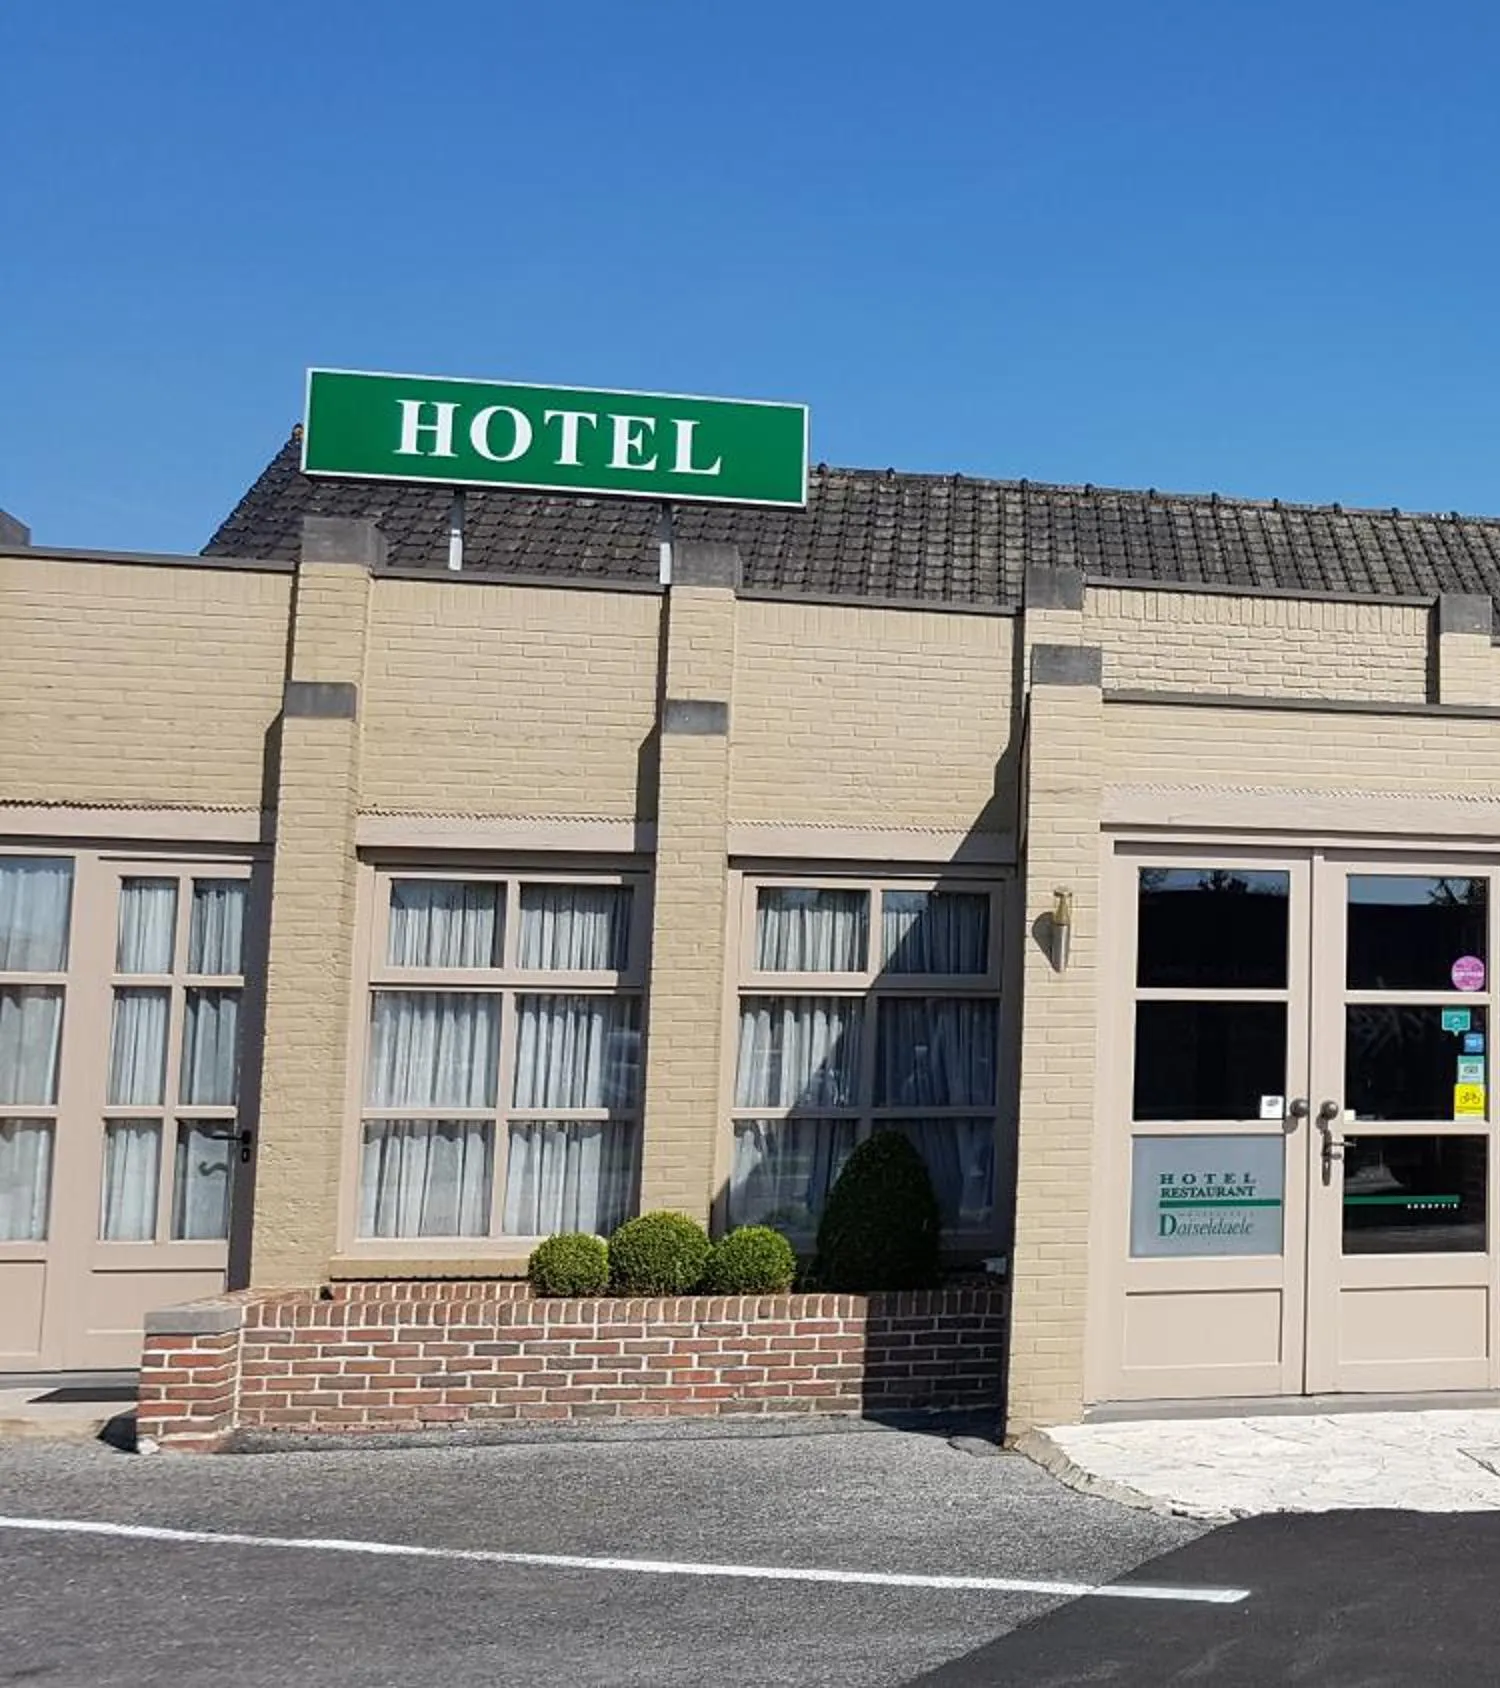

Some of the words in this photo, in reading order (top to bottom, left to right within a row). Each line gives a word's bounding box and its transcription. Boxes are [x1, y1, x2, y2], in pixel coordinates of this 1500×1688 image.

[393, 399, 723, 476] HOTEL
[1160, 1172, 1257, 1185] HOTEL
[1160, 1186, 1256, 1198] RESTAURANT
